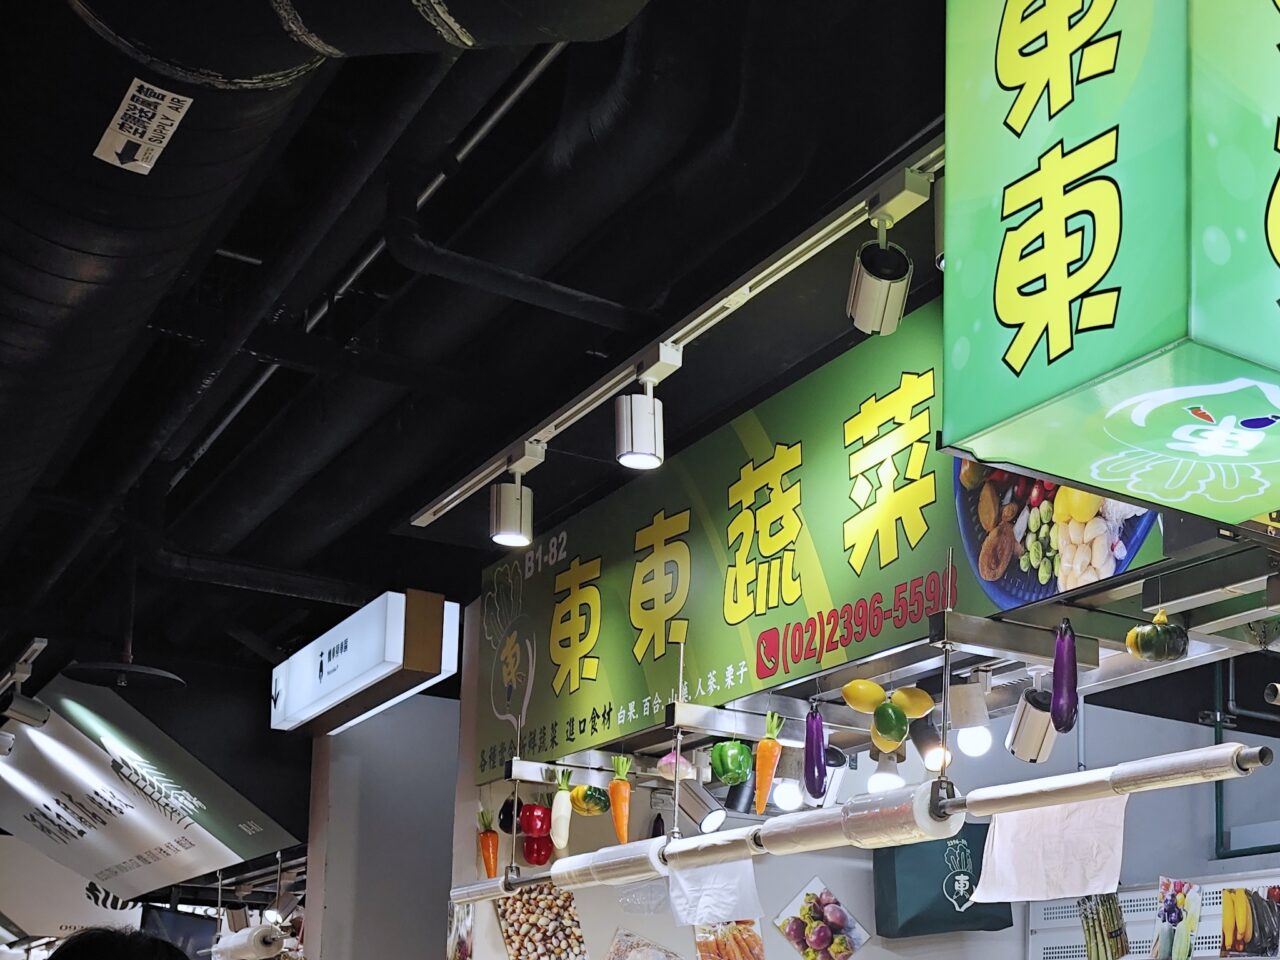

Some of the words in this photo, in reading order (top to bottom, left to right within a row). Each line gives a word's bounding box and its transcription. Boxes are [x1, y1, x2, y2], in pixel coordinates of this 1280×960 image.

[148, 114, 176, 144] SUPPLY
[167, 97, 187, 113] AIR
[524, 532, 567, 579] B1-82
[549, 368, 937, 698] 東東蔬菜
[566, 702, 613, 743] 進口食材
